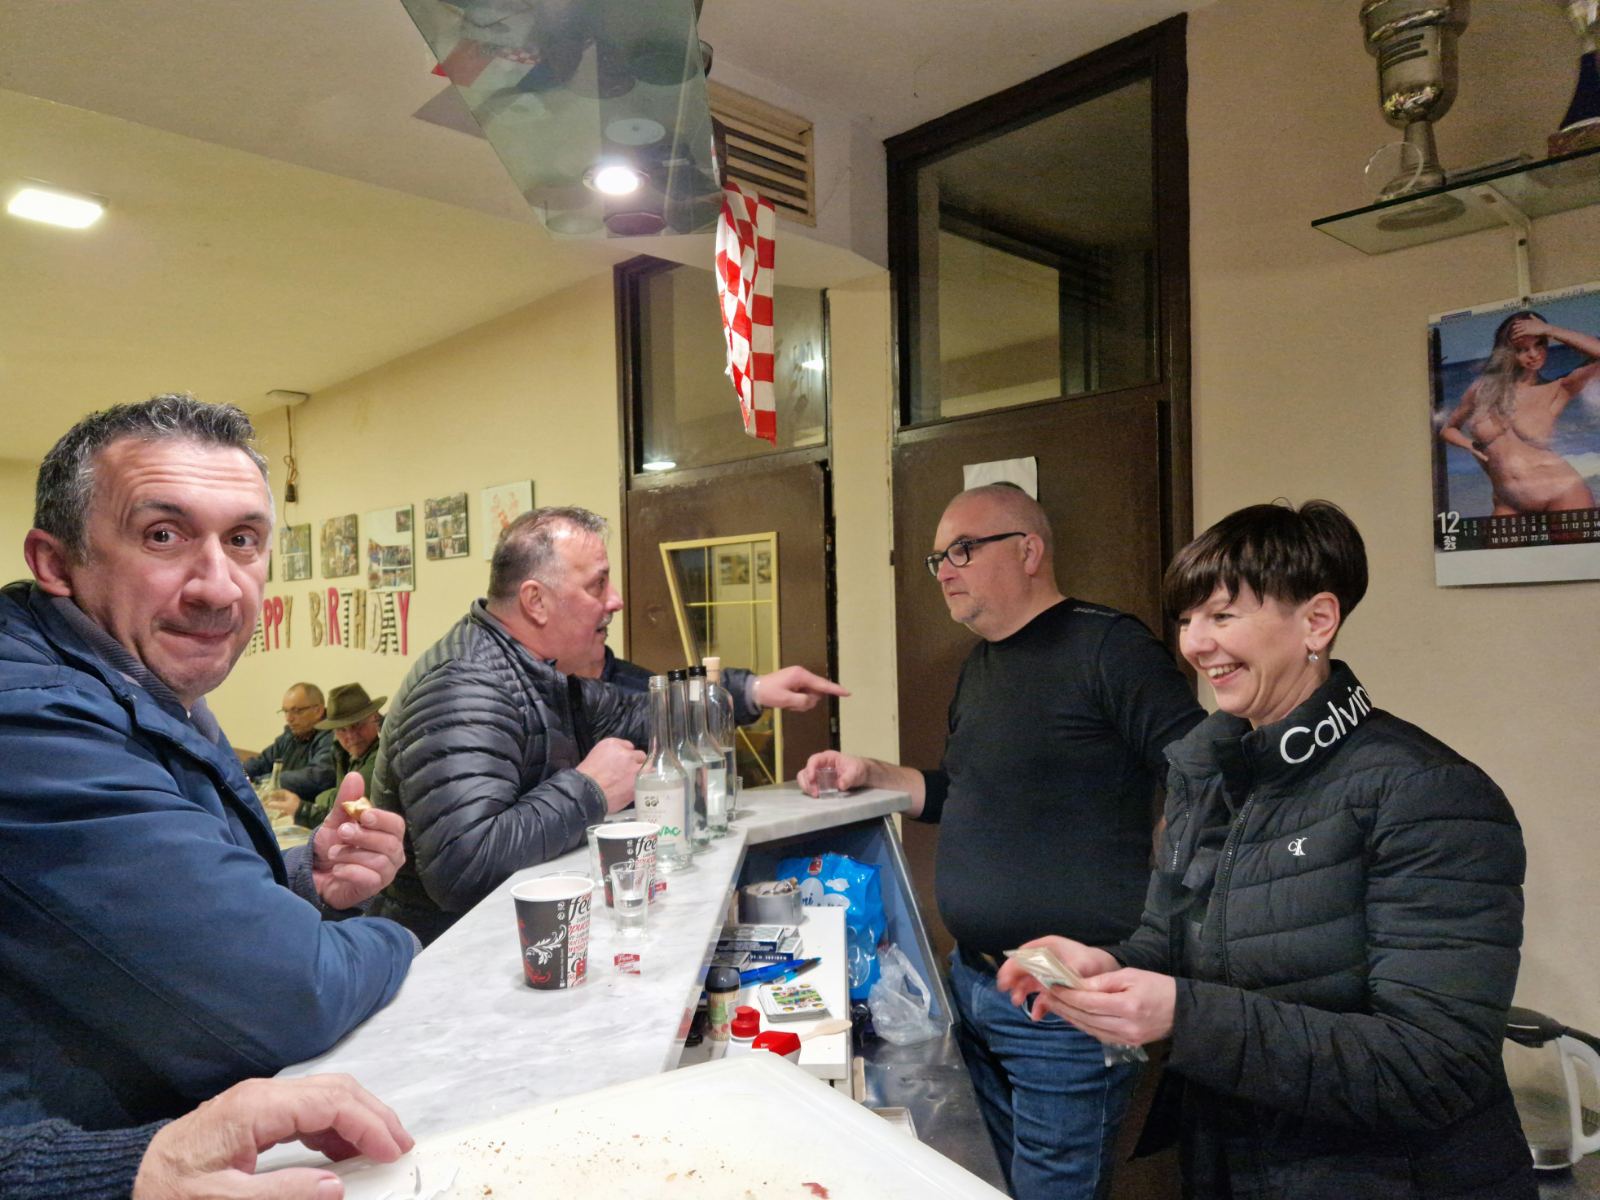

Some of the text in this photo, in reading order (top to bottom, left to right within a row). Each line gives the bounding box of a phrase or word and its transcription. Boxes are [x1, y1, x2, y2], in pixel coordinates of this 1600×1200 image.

[1437, 511, 1460, 534] 12
[244, 586, 411, 657] APPY BIRTHDAY
[1280, 685, 1371, 764] Calvin
